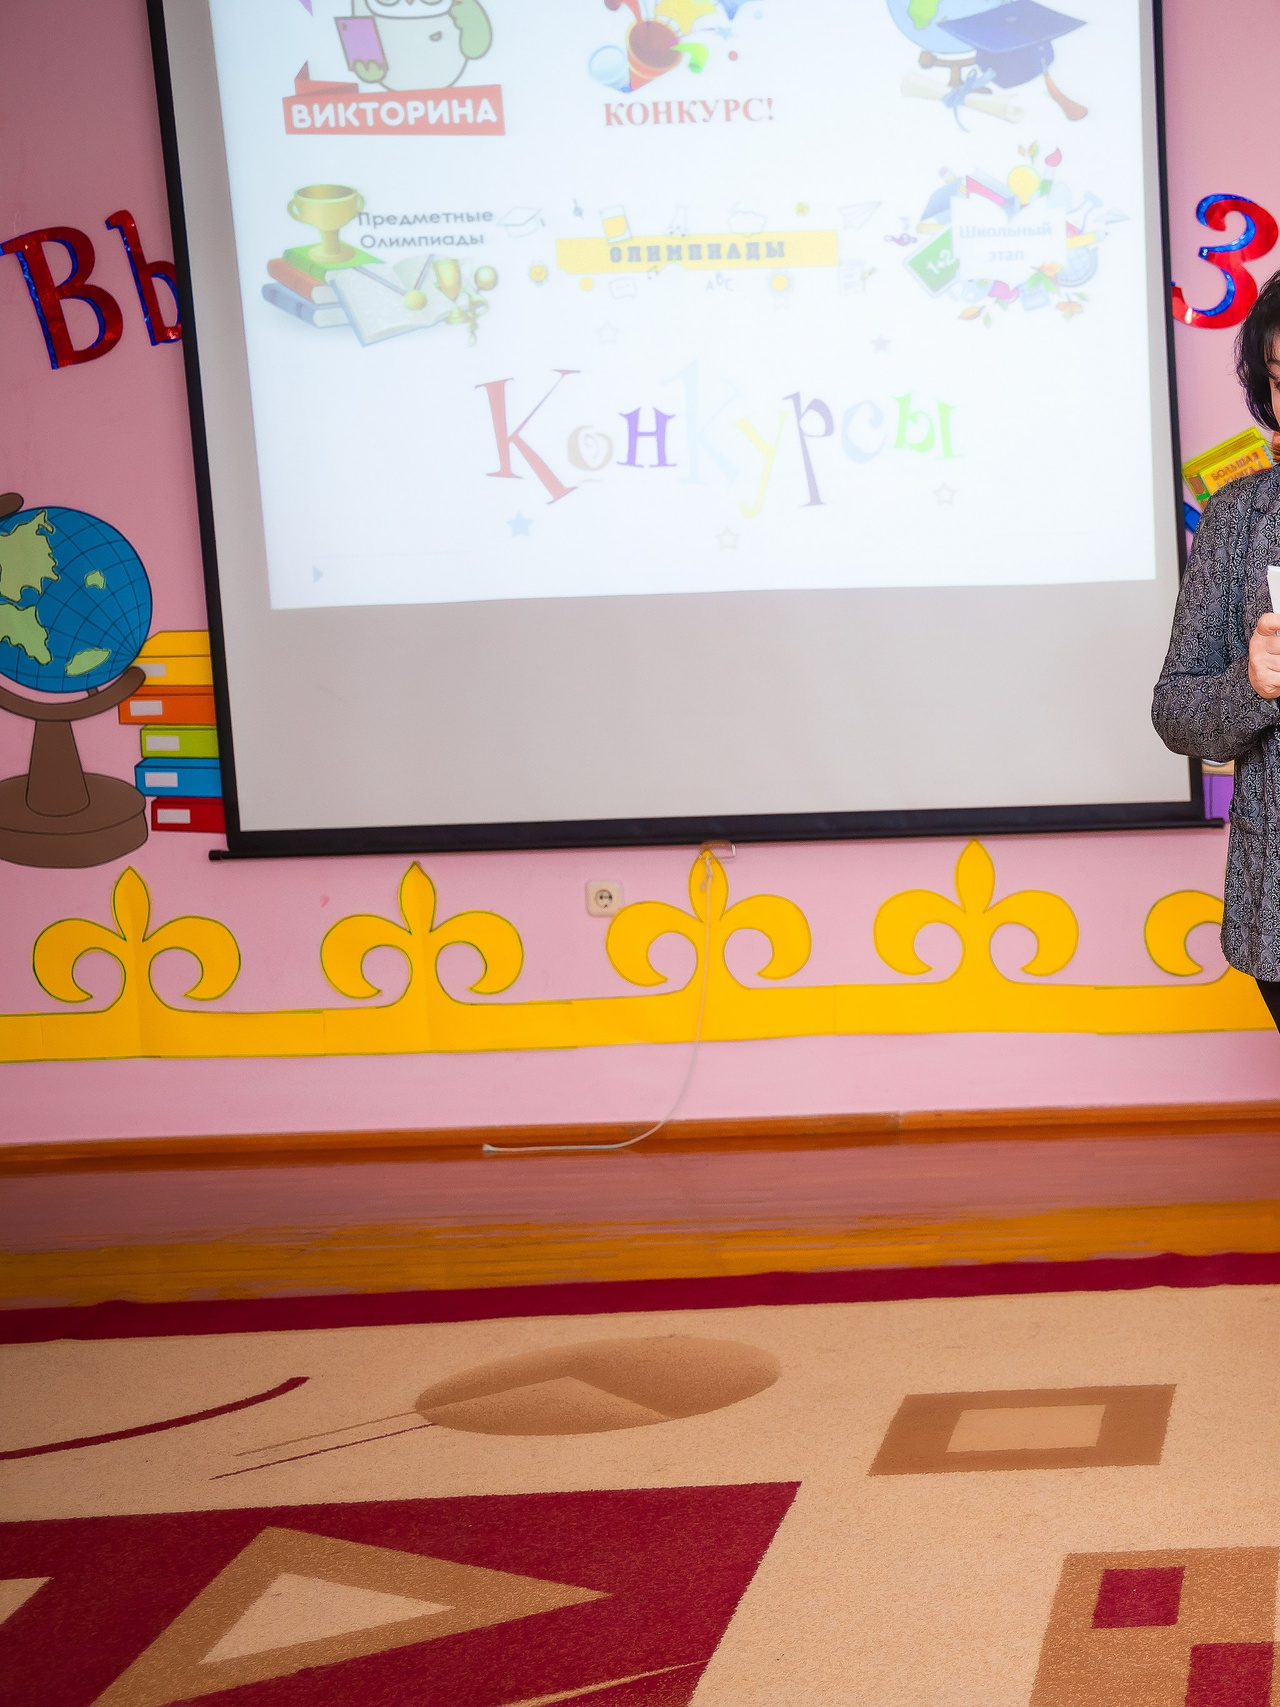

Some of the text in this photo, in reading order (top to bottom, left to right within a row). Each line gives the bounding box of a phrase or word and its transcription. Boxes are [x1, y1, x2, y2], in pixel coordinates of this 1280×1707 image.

[291, 98, 498, 129] ВИКТОРИНА
[603, 97, 775, 126] КОНКУРС!
[357, 209, 494, 228] Предметные
[959, 221, 1052, 239] Школьный
[360, 232, 485, 250] Олимпиады
[609, 241, 786, 263] ОЛИМПИАДЫ
[988, 249, 1025, 263] этап
[474, 358, 964, 518] Конкурсы
